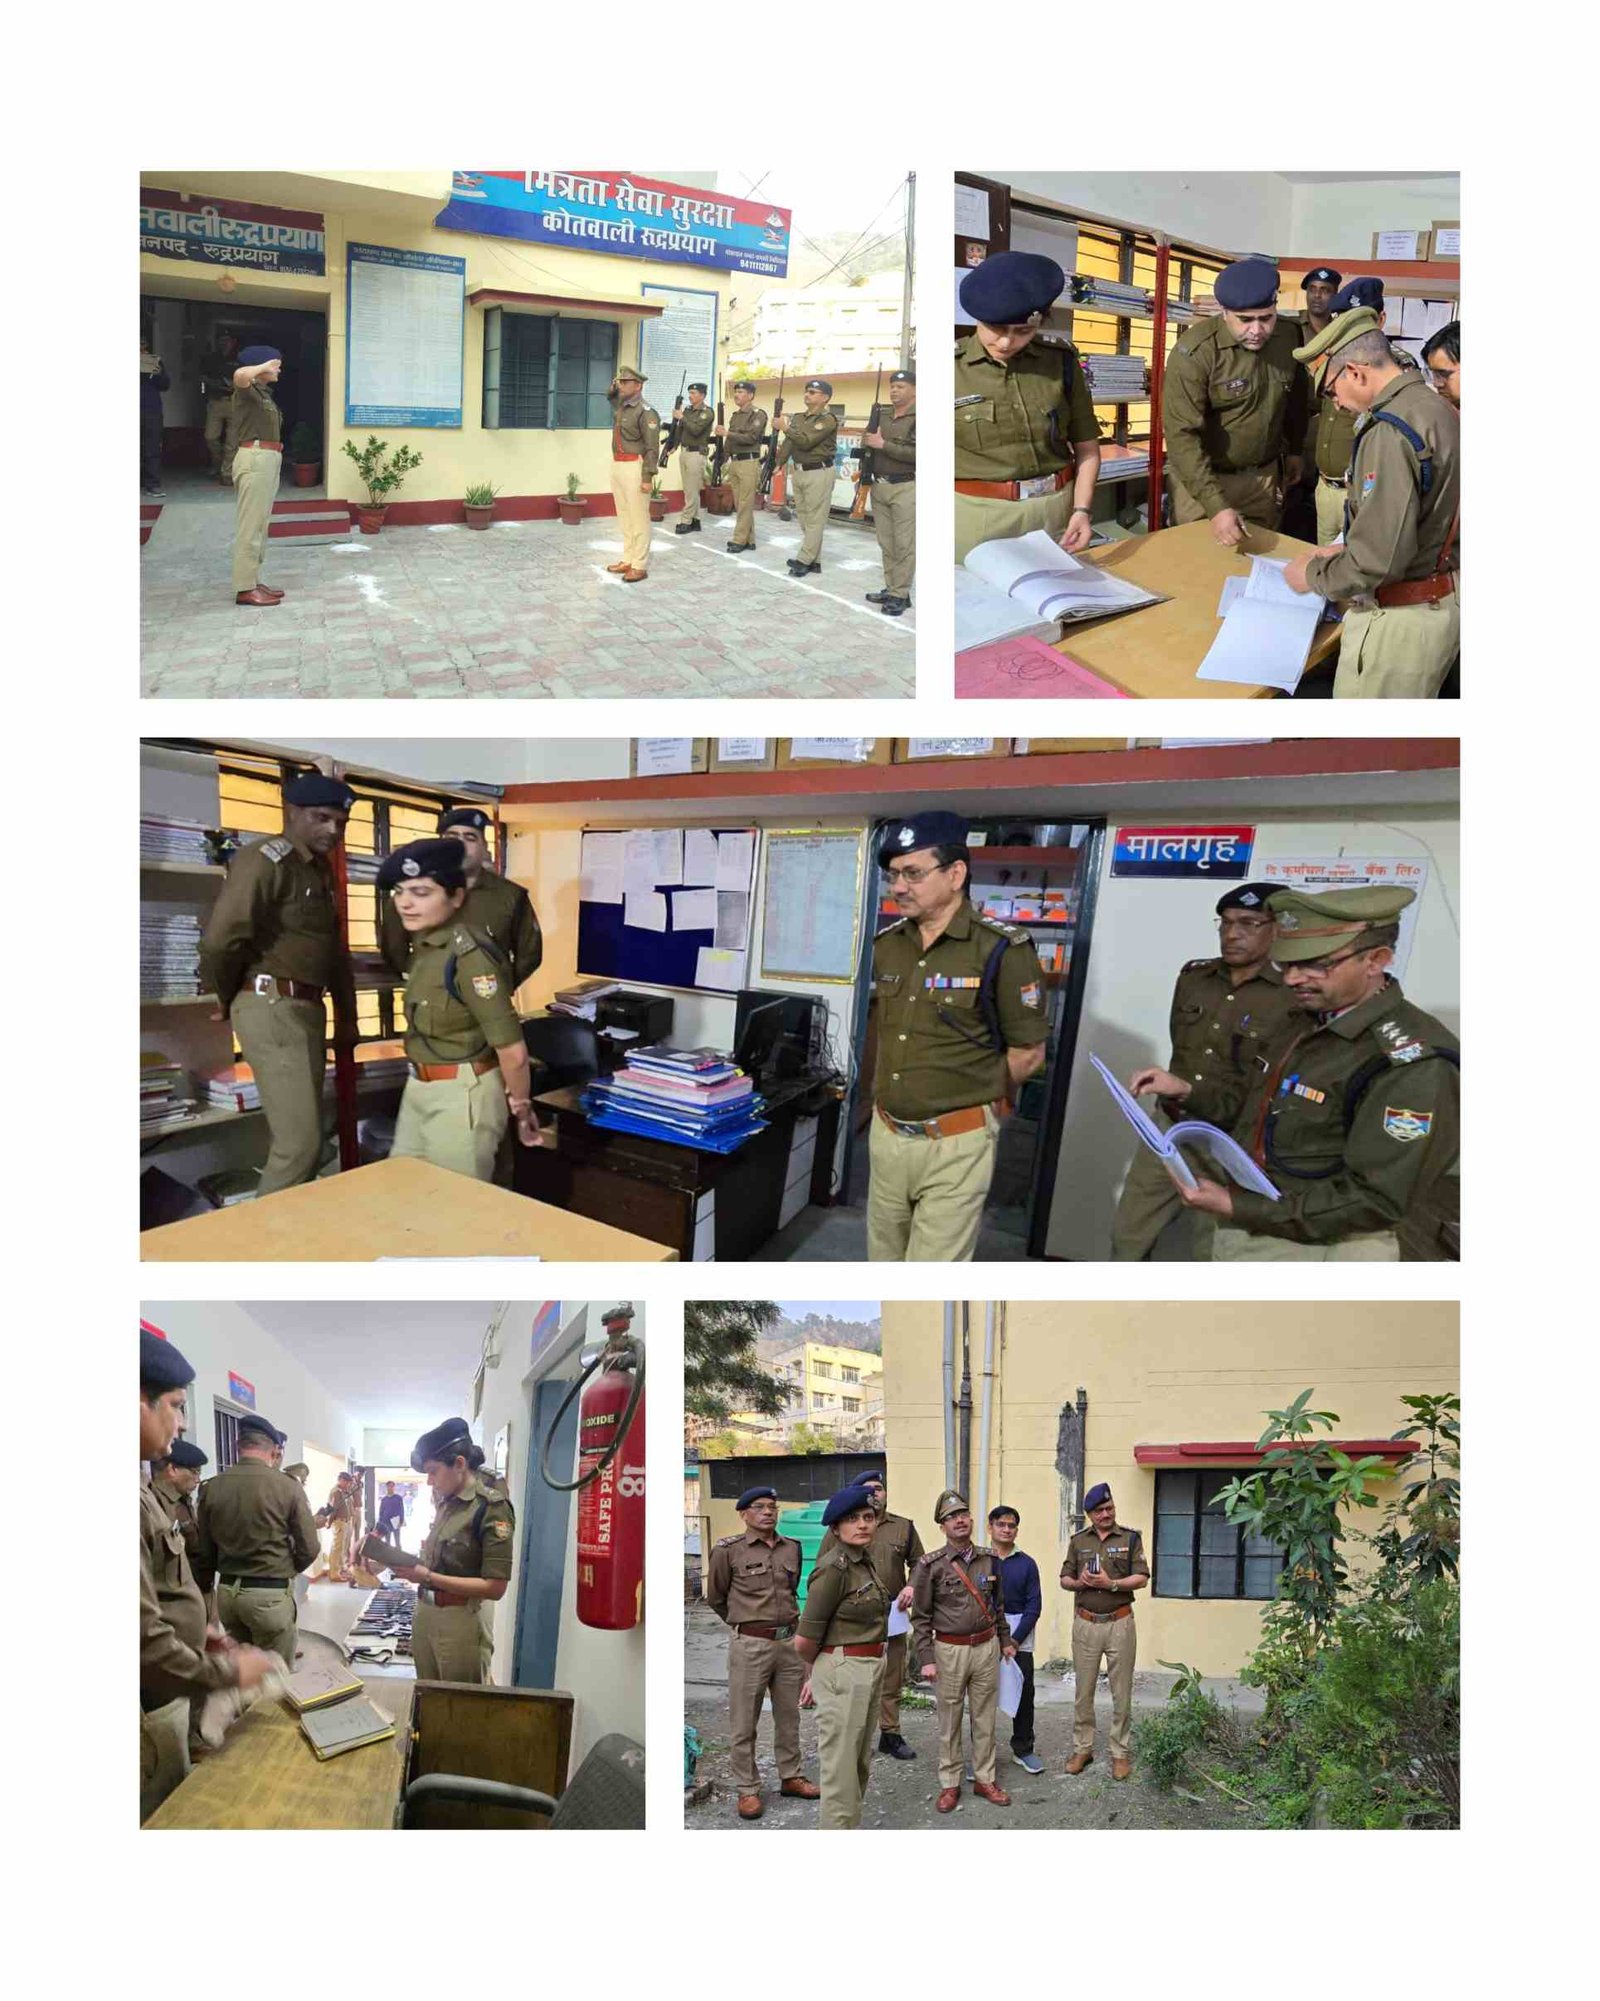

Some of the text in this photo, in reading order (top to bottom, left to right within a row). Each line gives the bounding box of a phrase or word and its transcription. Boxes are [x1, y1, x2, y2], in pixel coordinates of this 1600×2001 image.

[542, 206, 637, 244] कोतवाली
[614, 178, 666, 218] सेवा
[670, 194, 735, 231] सुरक्षा
[1127, 835, 1240, 869] मालगृह
[598, 1498, 612, 1544] SAFE
